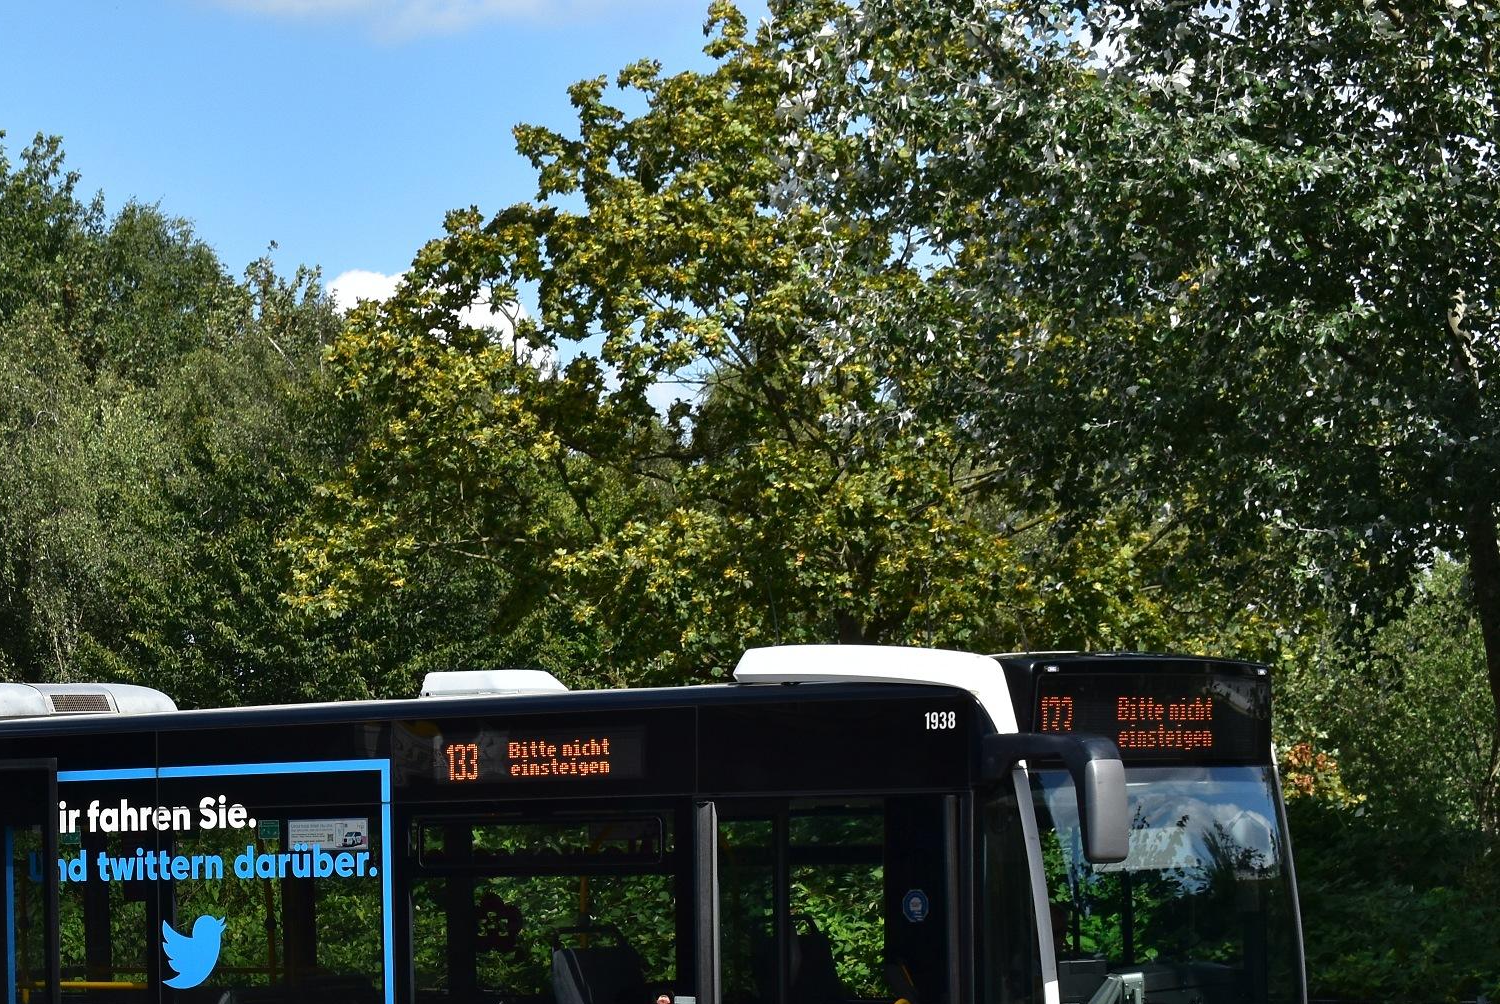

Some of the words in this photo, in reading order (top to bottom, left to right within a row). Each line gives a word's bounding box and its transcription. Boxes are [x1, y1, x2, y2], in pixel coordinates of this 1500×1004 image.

[924, 711, 956, 730] 1938
[1117, 697, 1165, 720] Bitte
[1169, 697, 1213, 720] nicht
[508, 741, 557, 758] Bitte
[562, 739, 610, 757] nicht
[1118, 724, 1213, 750] einsteigen
[446, 743, 478, 780] 133
[510, 758, 610, 776] einsteigen
[57, 800, 81, 833] ir
[87, 798, 191, 833] fahren
[199, 794, 257, 830] Sie.
[97, 847, 224, 882] twittern
[233, 844, 378, 879] darüber.
